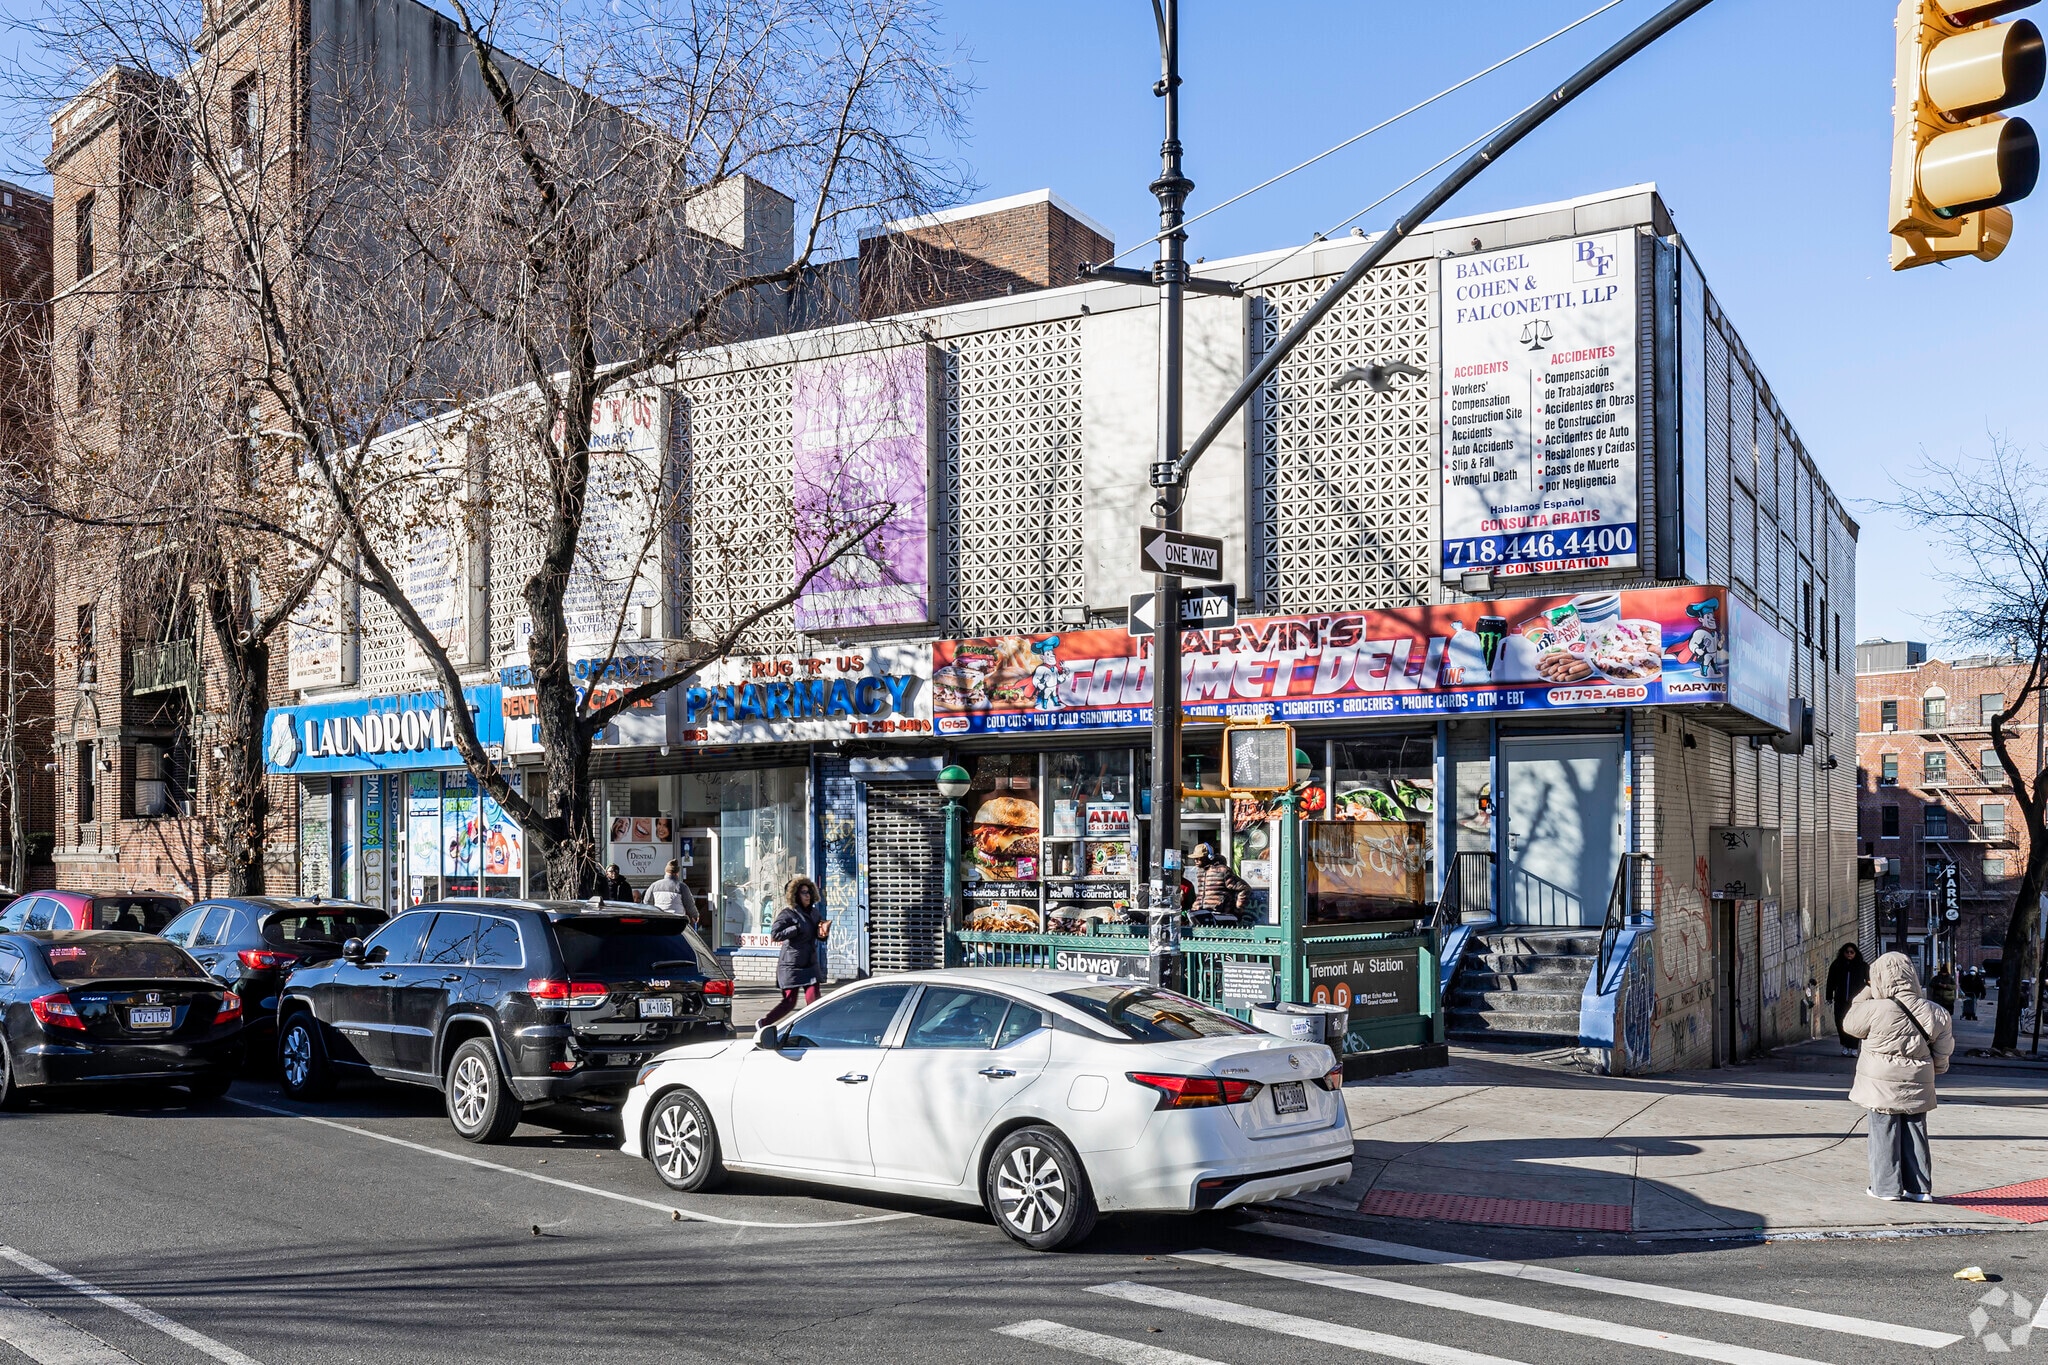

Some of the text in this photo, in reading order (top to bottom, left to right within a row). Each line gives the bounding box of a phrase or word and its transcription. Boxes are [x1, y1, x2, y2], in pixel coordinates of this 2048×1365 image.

[1456, 254, 1529, 279] BANGEL
[1457, 275, 1537, 301] COHEN &
[1457, 285, 1618, 323] FALCONETTI, LLP
[1551, 346, 1615, 365] ACCIDENTES
[1454, 361, 1509, 378] ACCIDENTS
[1545, 364, 1609, 384] Compensación
[1452, 382, 1488, 396] Workers'
[1545, 382, 1614, 400] de Trabajadores
[1452, 395, 1510, 411] Compensation
[1545, 395, 1635, 416] Accidentes en Obras
[1452, 408, 1522, 427] Construction Site
[1545, 410, 1616, 431] de Construcción
[1452, 426, 1492, 441] Accidents
[1545, 426, 1629, 446] Accidentes de Auto
[1452, 440, 1514, 457] Auto Accidents
[1545, 441, 1635, 462] Resbalones y Caídas
[1452, 456, 1494, 472] Slip & Fall
[1545, 458, 1619, 477] Casos de Muerte
[1452, 469, 1517, 486] Wrongful Death
[1546, 474, 1616, 494] por Negligencia
[1490, 497, 1584, 515] Hablamos Español
[1481, 509, 1601, 532] CONSULTA GRATIS
[1448, 526, 1633, 565] 718.446.4400
[1166, 544, 1215, 567] ONE WAY
[1506, 556, 1609, 575] CONSULTATION
[632, 590, 656, 598] CCEPTED
[1191, 597, 1223, 617] WAY
[575, 655, 652, 680] OFFICE
[751, 655, 864, 678] RUG US
[1058, 637, 1465, 707] GOUMET DELI INC
[1549, 687, 1645, 702] 917.792.4880
[1669, 682, 1727, 695] MARVIN'S
[686, 674, 914, 723] PHARMACY
[940, 719, 969, 732] 1963
[986, 717, 1005, 729] COLD
[1007, 715, 1028, 728] CUTS
[1034, 714, 1049, 726] HOT
[1051, 714, 1057, 725] &
[1058, 713, 1078, 725] COLD
[1080, 710, 1132, 724] SANDWICHES
[1226, 702, 1274, 716] BEVERAGES
[1283, 700, 1334, 715] CIGARETTES
[1343, 697, 1393, 712] GROCERIES
[1402, 695, 1434, 710] PHONE
[1436, 693, 1467, 708] CARDS
[1477, 692, 1497, 707] ATM
[1507, 691, 1524, 705] EBT
[445, 770, 468, 788] FREE
[368, 774, 379, 806] TIME
[1089, 811, 1129, 823] ATM
[630, 852, 653, 860] DENTAL
[963, 888, 999, 897] Sandwiches
[1009, 889, 1020, 897] Hot
[1021, 889, 1037, 897] Food
[1081, 889, 1112, 898] Gourmet
[1947, 868, 1959, 908] PARK
[760, 936, 769, 946] US
[1057, 952, 1120, 976] Subway
[1310, 958, 1403, 978] Tremont Av Station
[649, 978, 671, 988] Jeep
[1317, 991, 1326, 1004] B
[1338, 989, 1347, 1006] D
